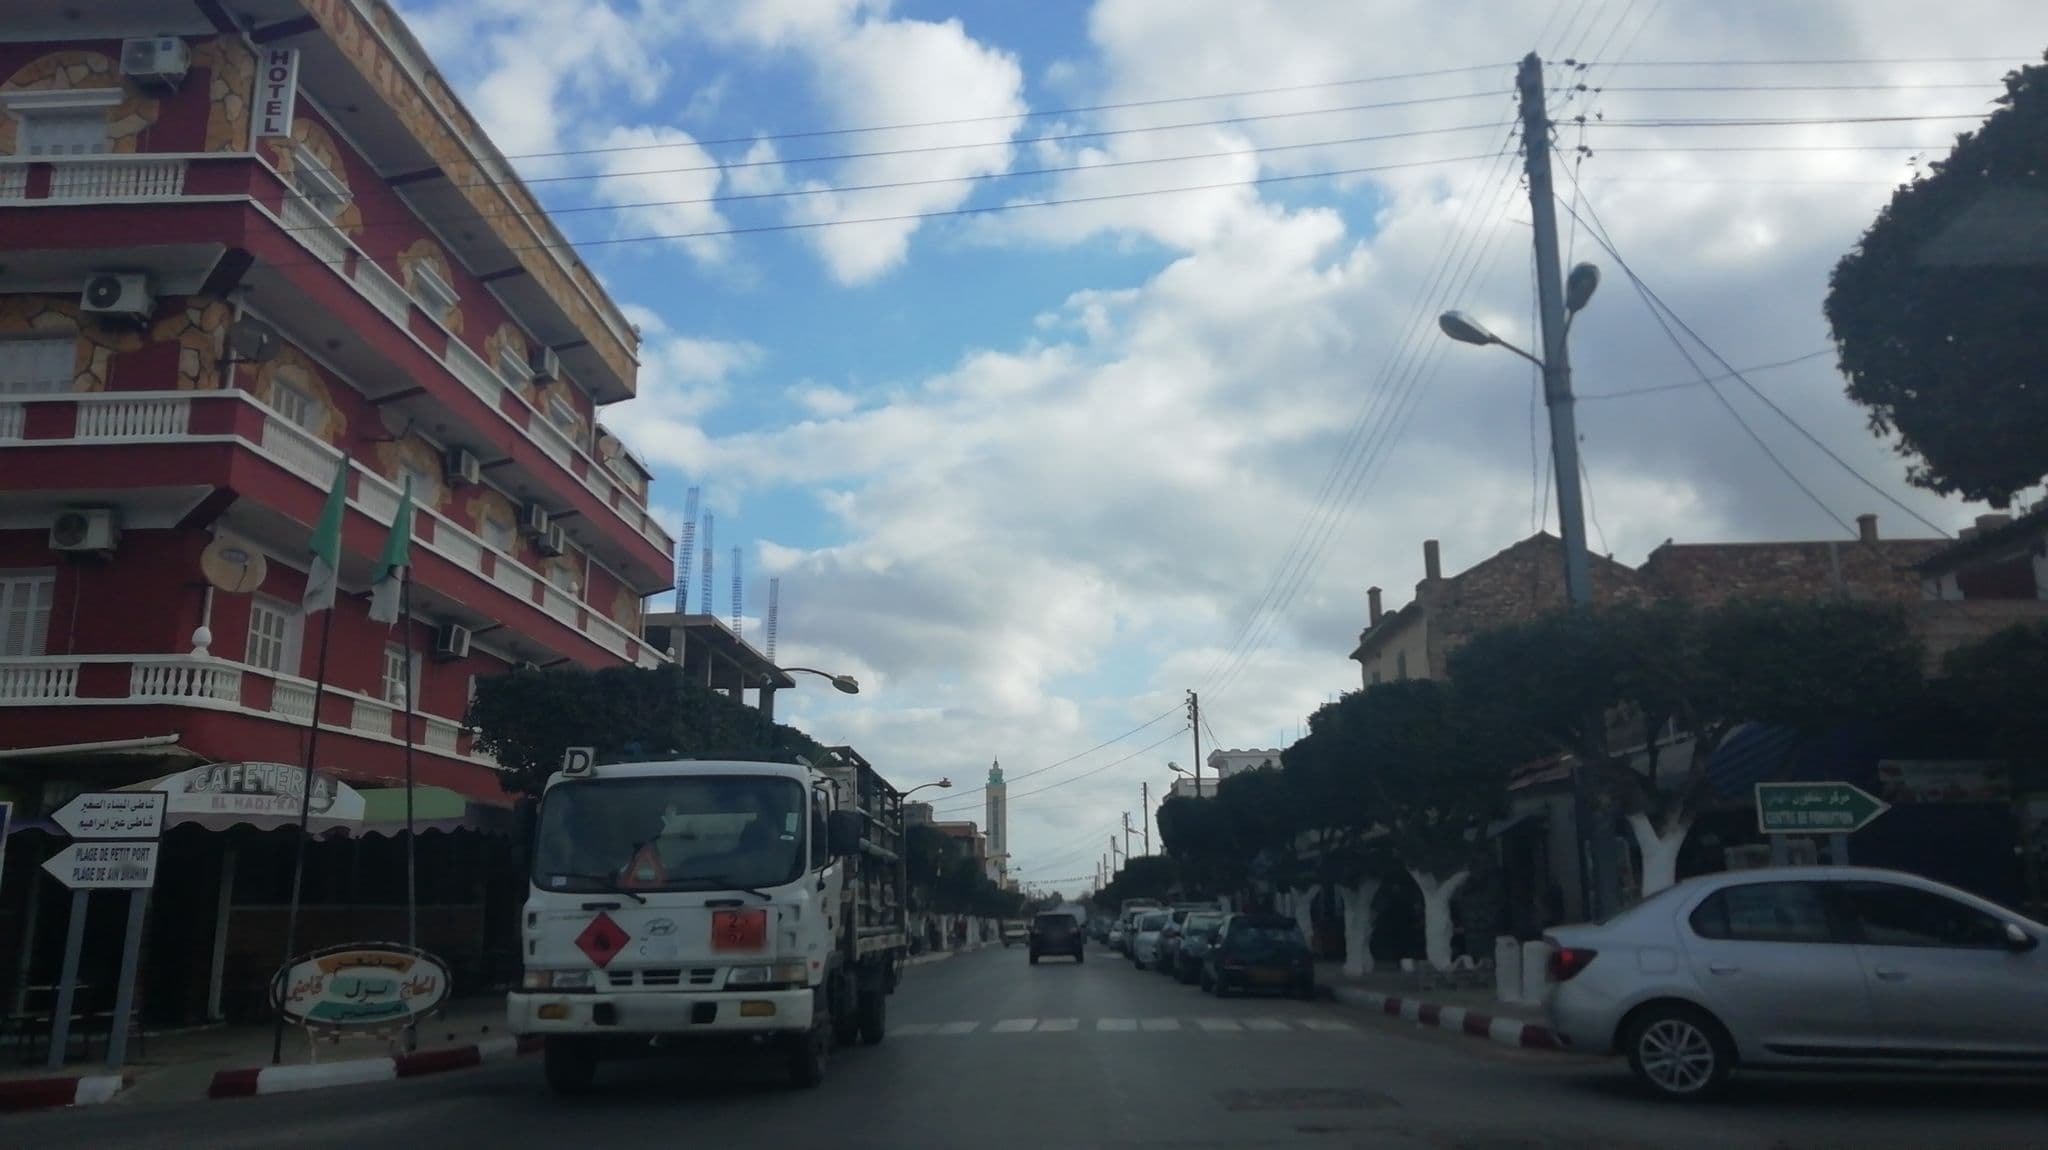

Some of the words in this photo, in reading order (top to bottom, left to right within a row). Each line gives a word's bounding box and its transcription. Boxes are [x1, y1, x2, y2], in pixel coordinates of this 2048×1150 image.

[264, 50, 289, 133] HOTEL
[565, 750, 590, 774] D
[193, 763, 329, 799] CAFETERA
[211, 796, 227, 809] EL
[110, 818, 126, 831] عين
[76, 847, 98, 861] PLAGE
[99, 847, 109, 861] DE
[110, 847, 131, 861] PETIT
[131, 847, 150, 861] PORT
[72, 867, 95, 881] PLAGE
[96, 867, 106, 881] DE
[399, 975, 437, 1001] الحاج
